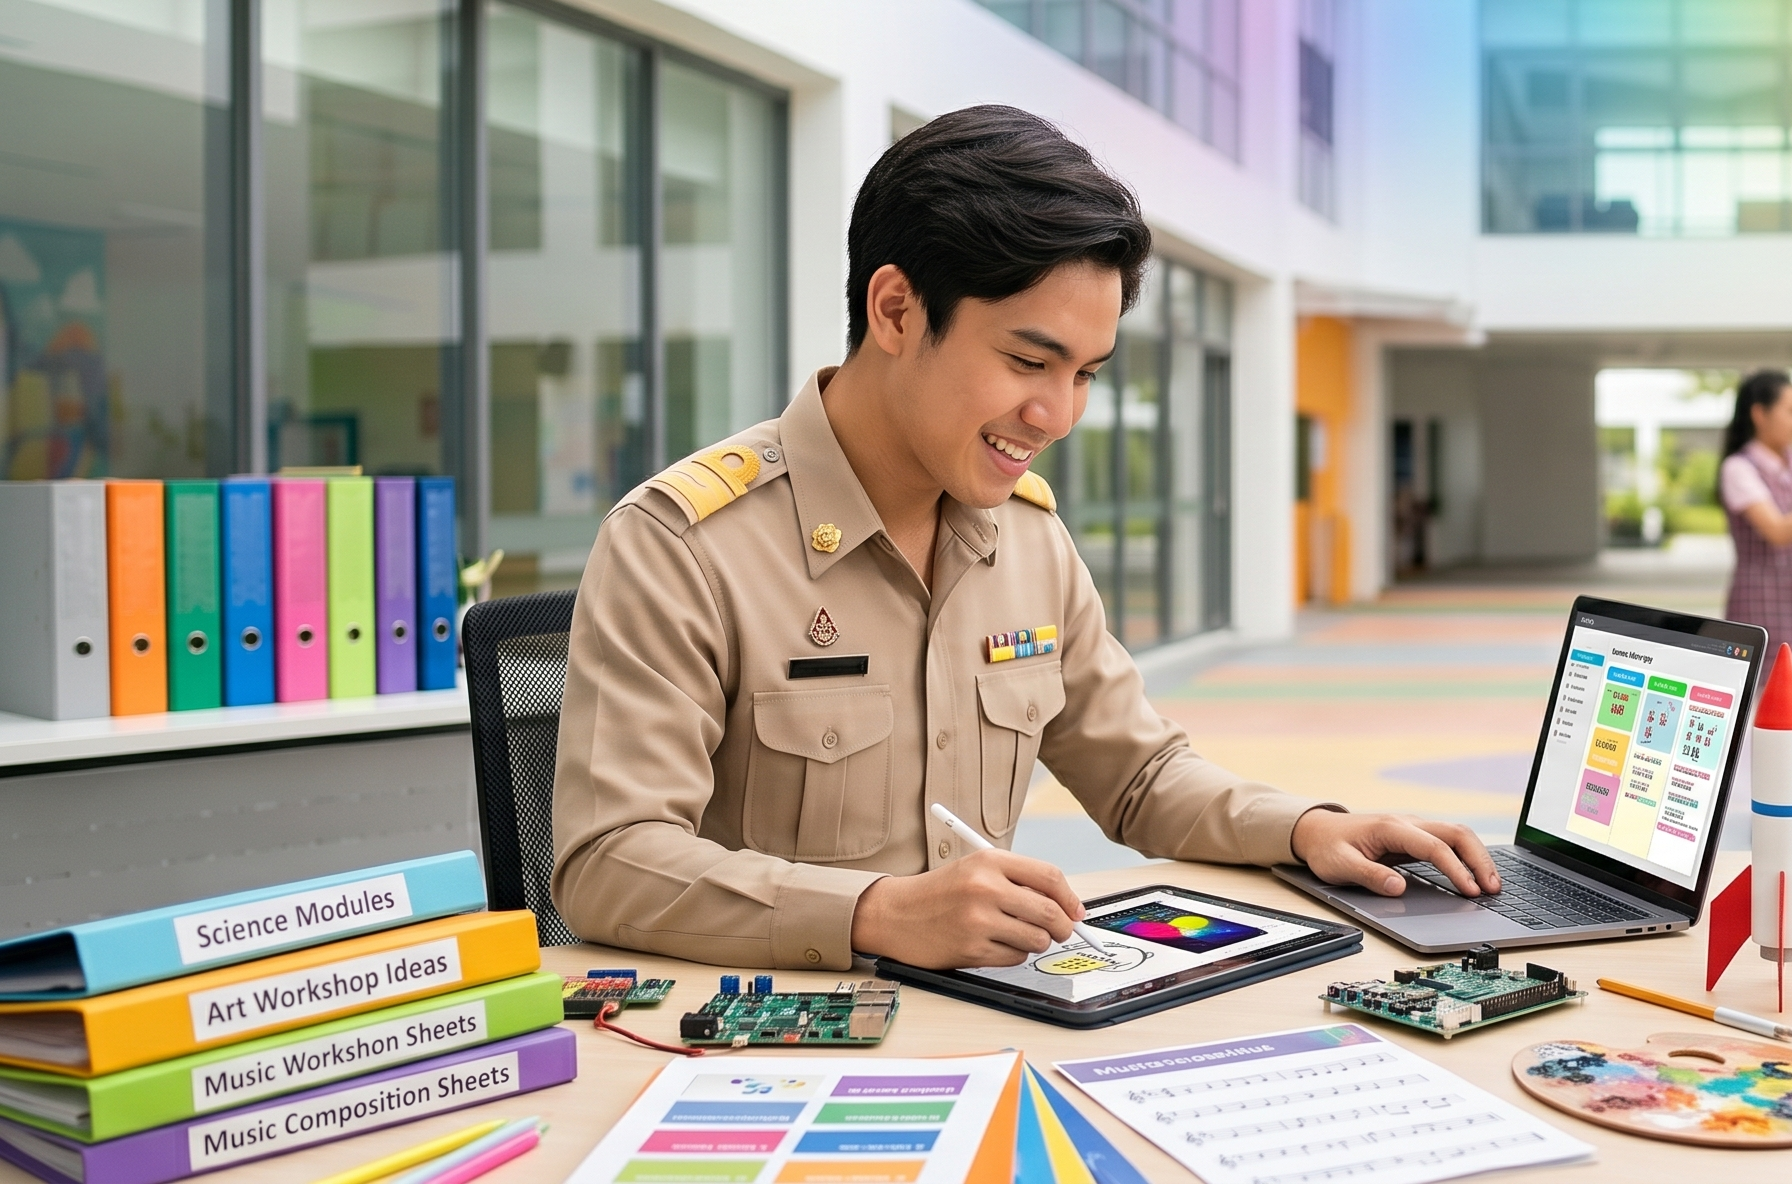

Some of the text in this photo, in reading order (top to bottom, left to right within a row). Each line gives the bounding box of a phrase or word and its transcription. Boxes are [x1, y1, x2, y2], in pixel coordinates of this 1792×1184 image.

[197, 890, 395, 948] Science Modules
[207, 954, 447, 1026] Art Workshop Ideas
[204, 1062, 276, 1097] Music
[405, 1014, 477, 1046] Sheets
[203, 1066, 510, 1155] Music Composition Sheets
